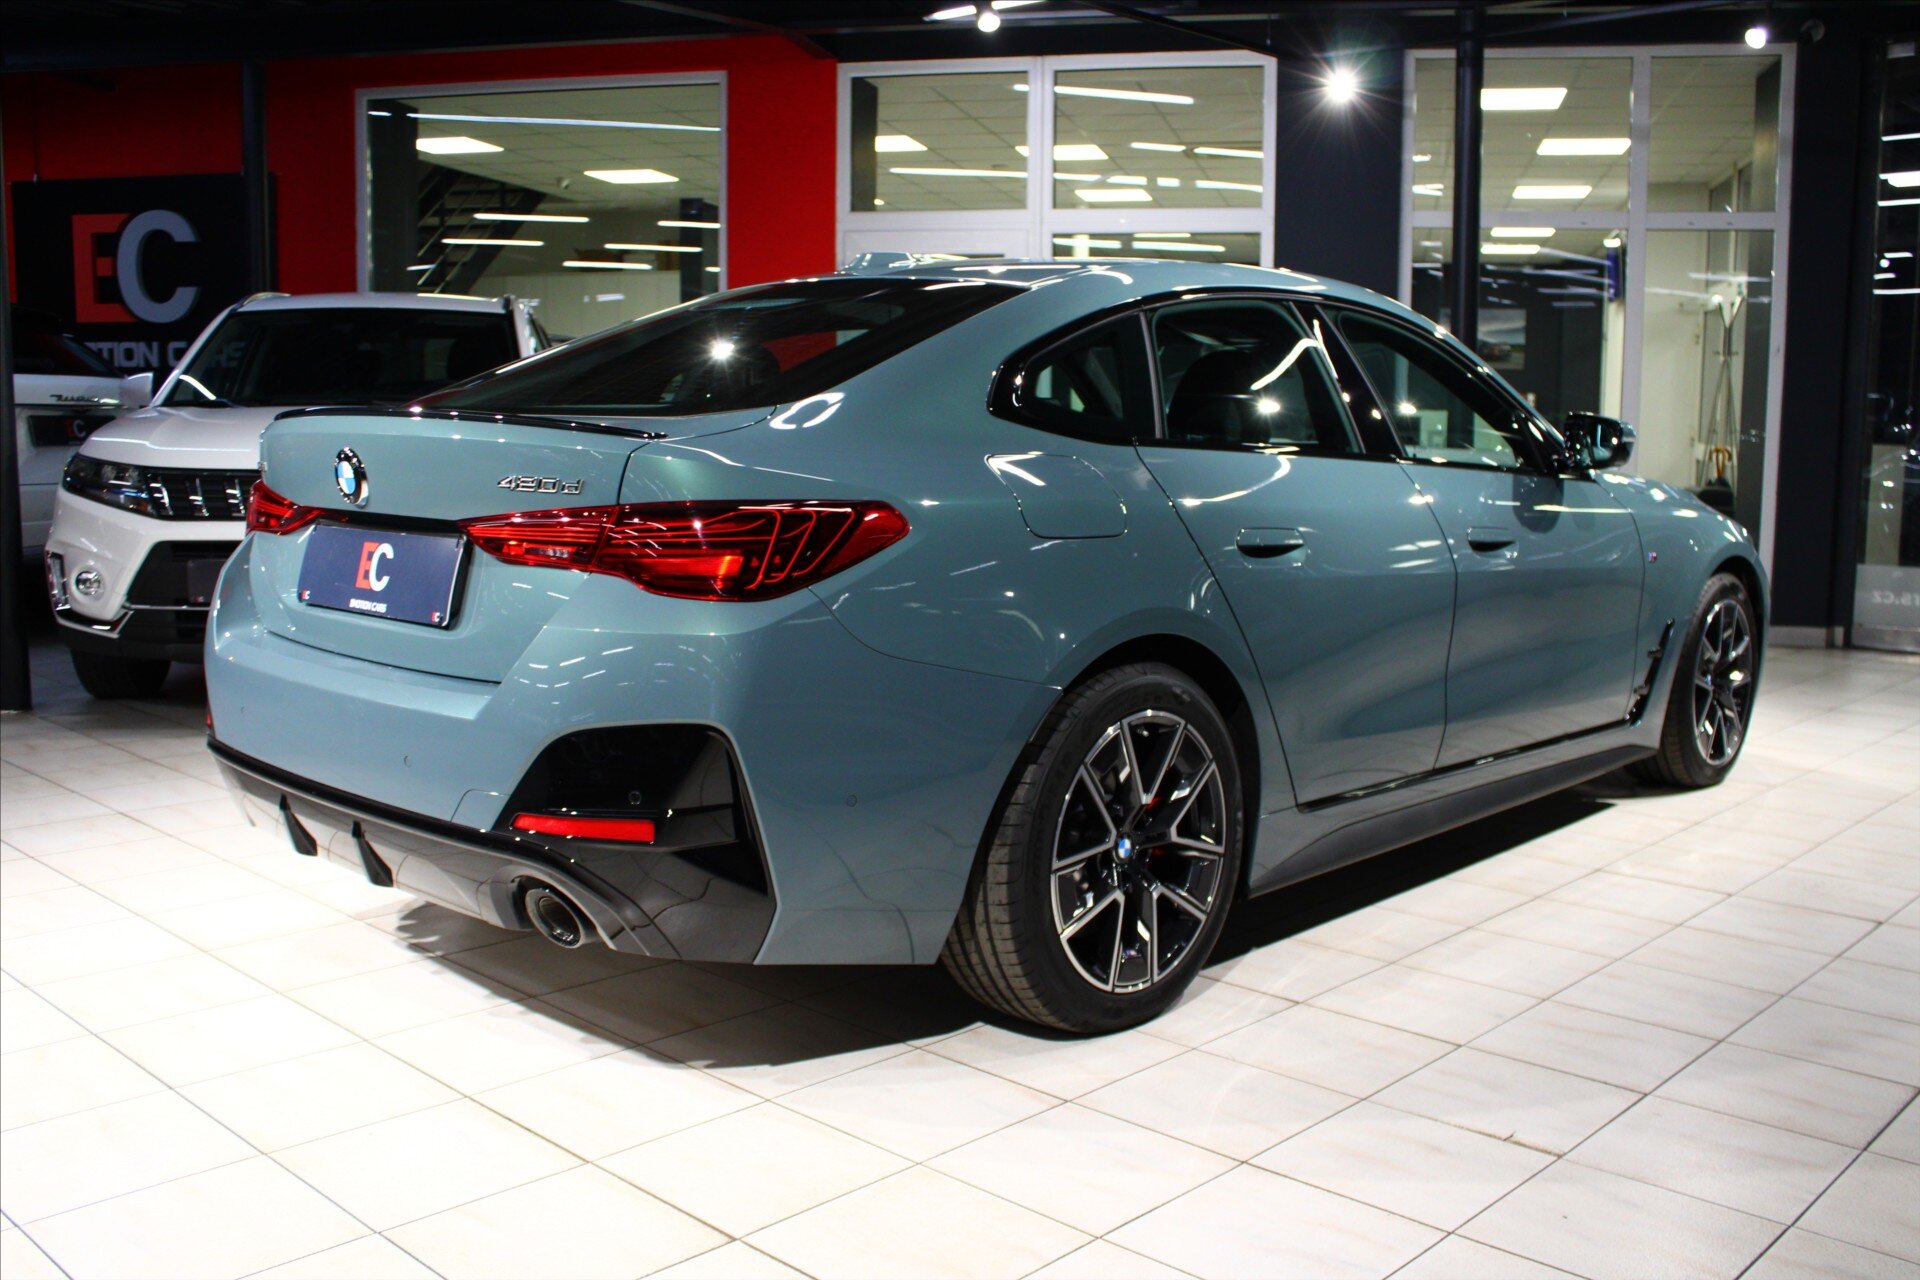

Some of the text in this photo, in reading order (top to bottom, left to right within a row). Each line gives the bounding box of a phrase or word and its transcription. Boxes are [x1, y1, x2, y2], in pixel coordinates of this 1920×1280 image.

[72, 209, 200, 323] EC
[497, 475, 585, 495] 420d
[355, 541, 394, 592] EC
